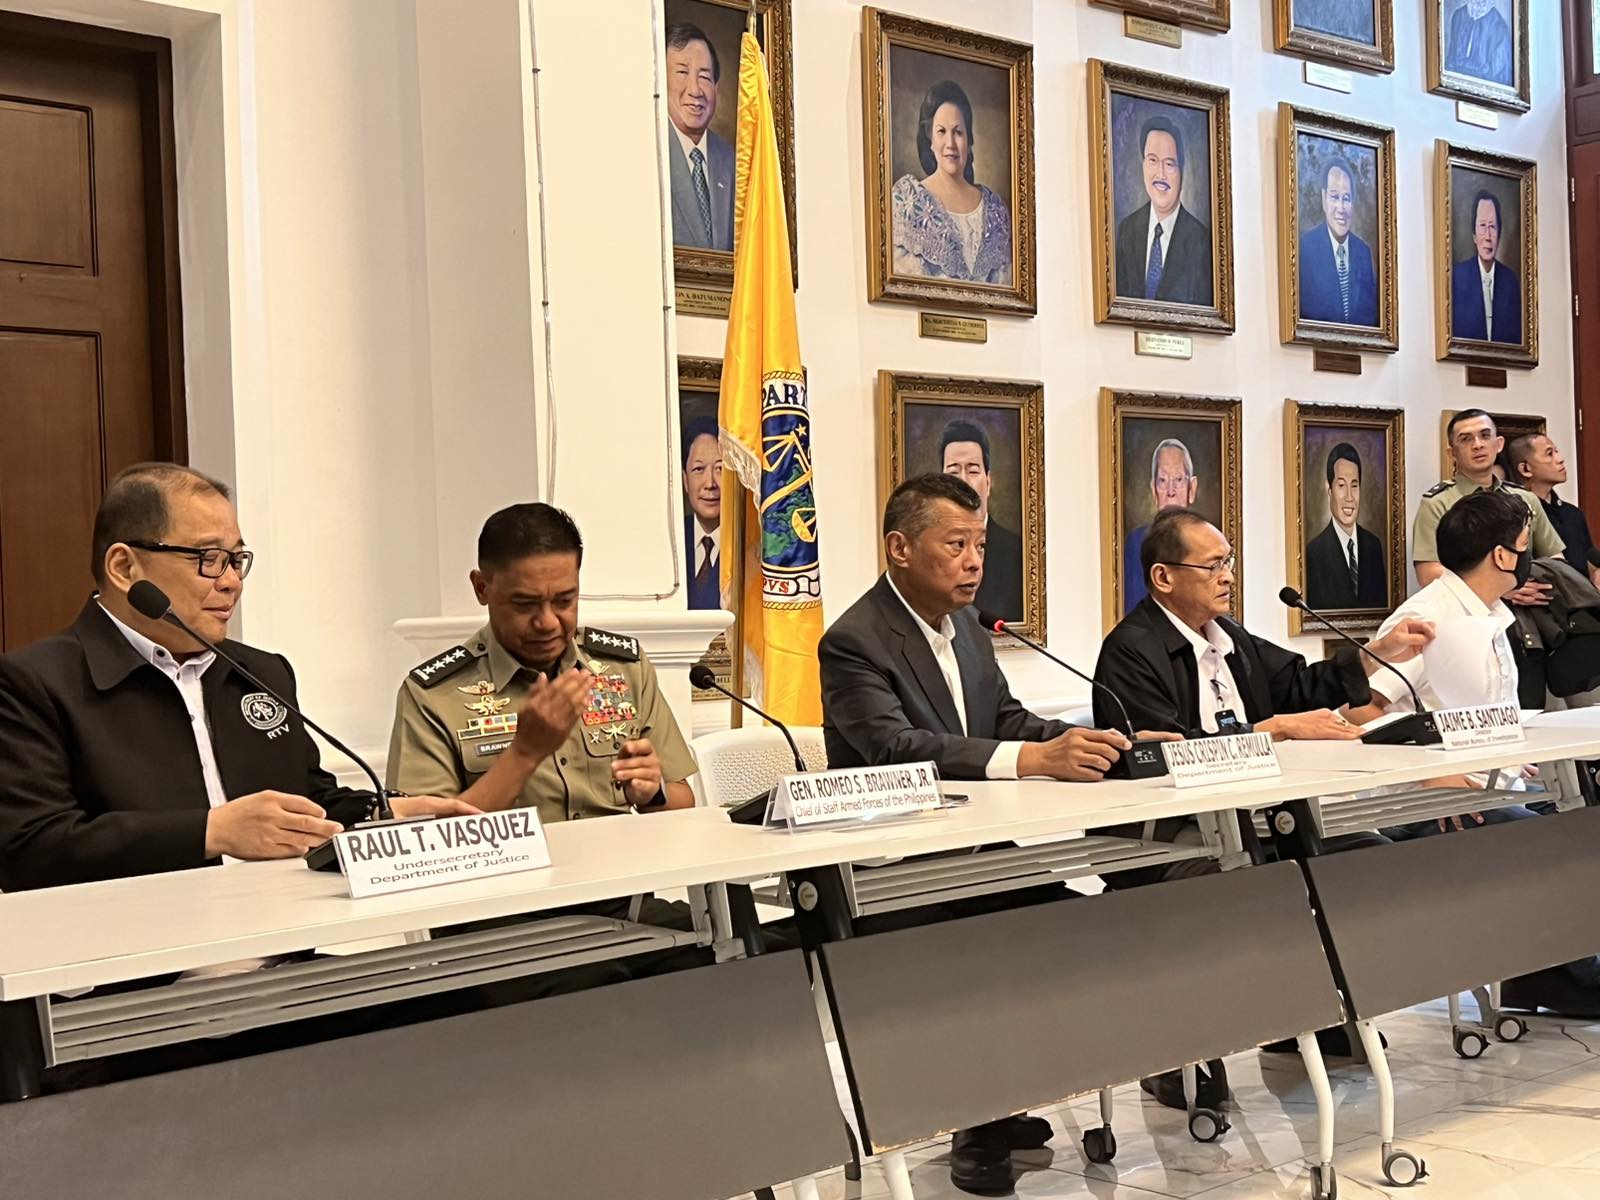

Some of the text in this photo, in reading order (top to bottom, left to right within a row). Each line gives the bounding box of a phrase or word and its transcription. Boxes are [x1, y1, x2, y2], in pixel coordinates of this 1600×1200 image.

[266, 723, 290, 740] RTV
[1438, 711, 1468, 733] JAIME
[1466, 711, 1478, 730] B.
[1476, 705, 1519, 729] SANTIAGO
[1168, 741, 1196, 767] JESUS
[1194, 738, 1231, 764] CRISPIN
[1228, 737, 1239, 760] C.
[1235, 733, 1274, 759] REMULLA
[1177, 767, 1233, 779] Department
[1247, 762, 1276, 771] Justice
[1205, 759, 1248, 770] Secretary
[789, 768, 932, 801] GEN. ROMEO S. BRAWNER, JR.
[796, 791, 937, 818] Chief of Staff Armed Forces of the Philippines
[347, 811, 535, 863] RAUL T. VASQUEZ
[370, 853, 530, 885] Department of Justice
[393, 848, 504, 871] Undersecretary
